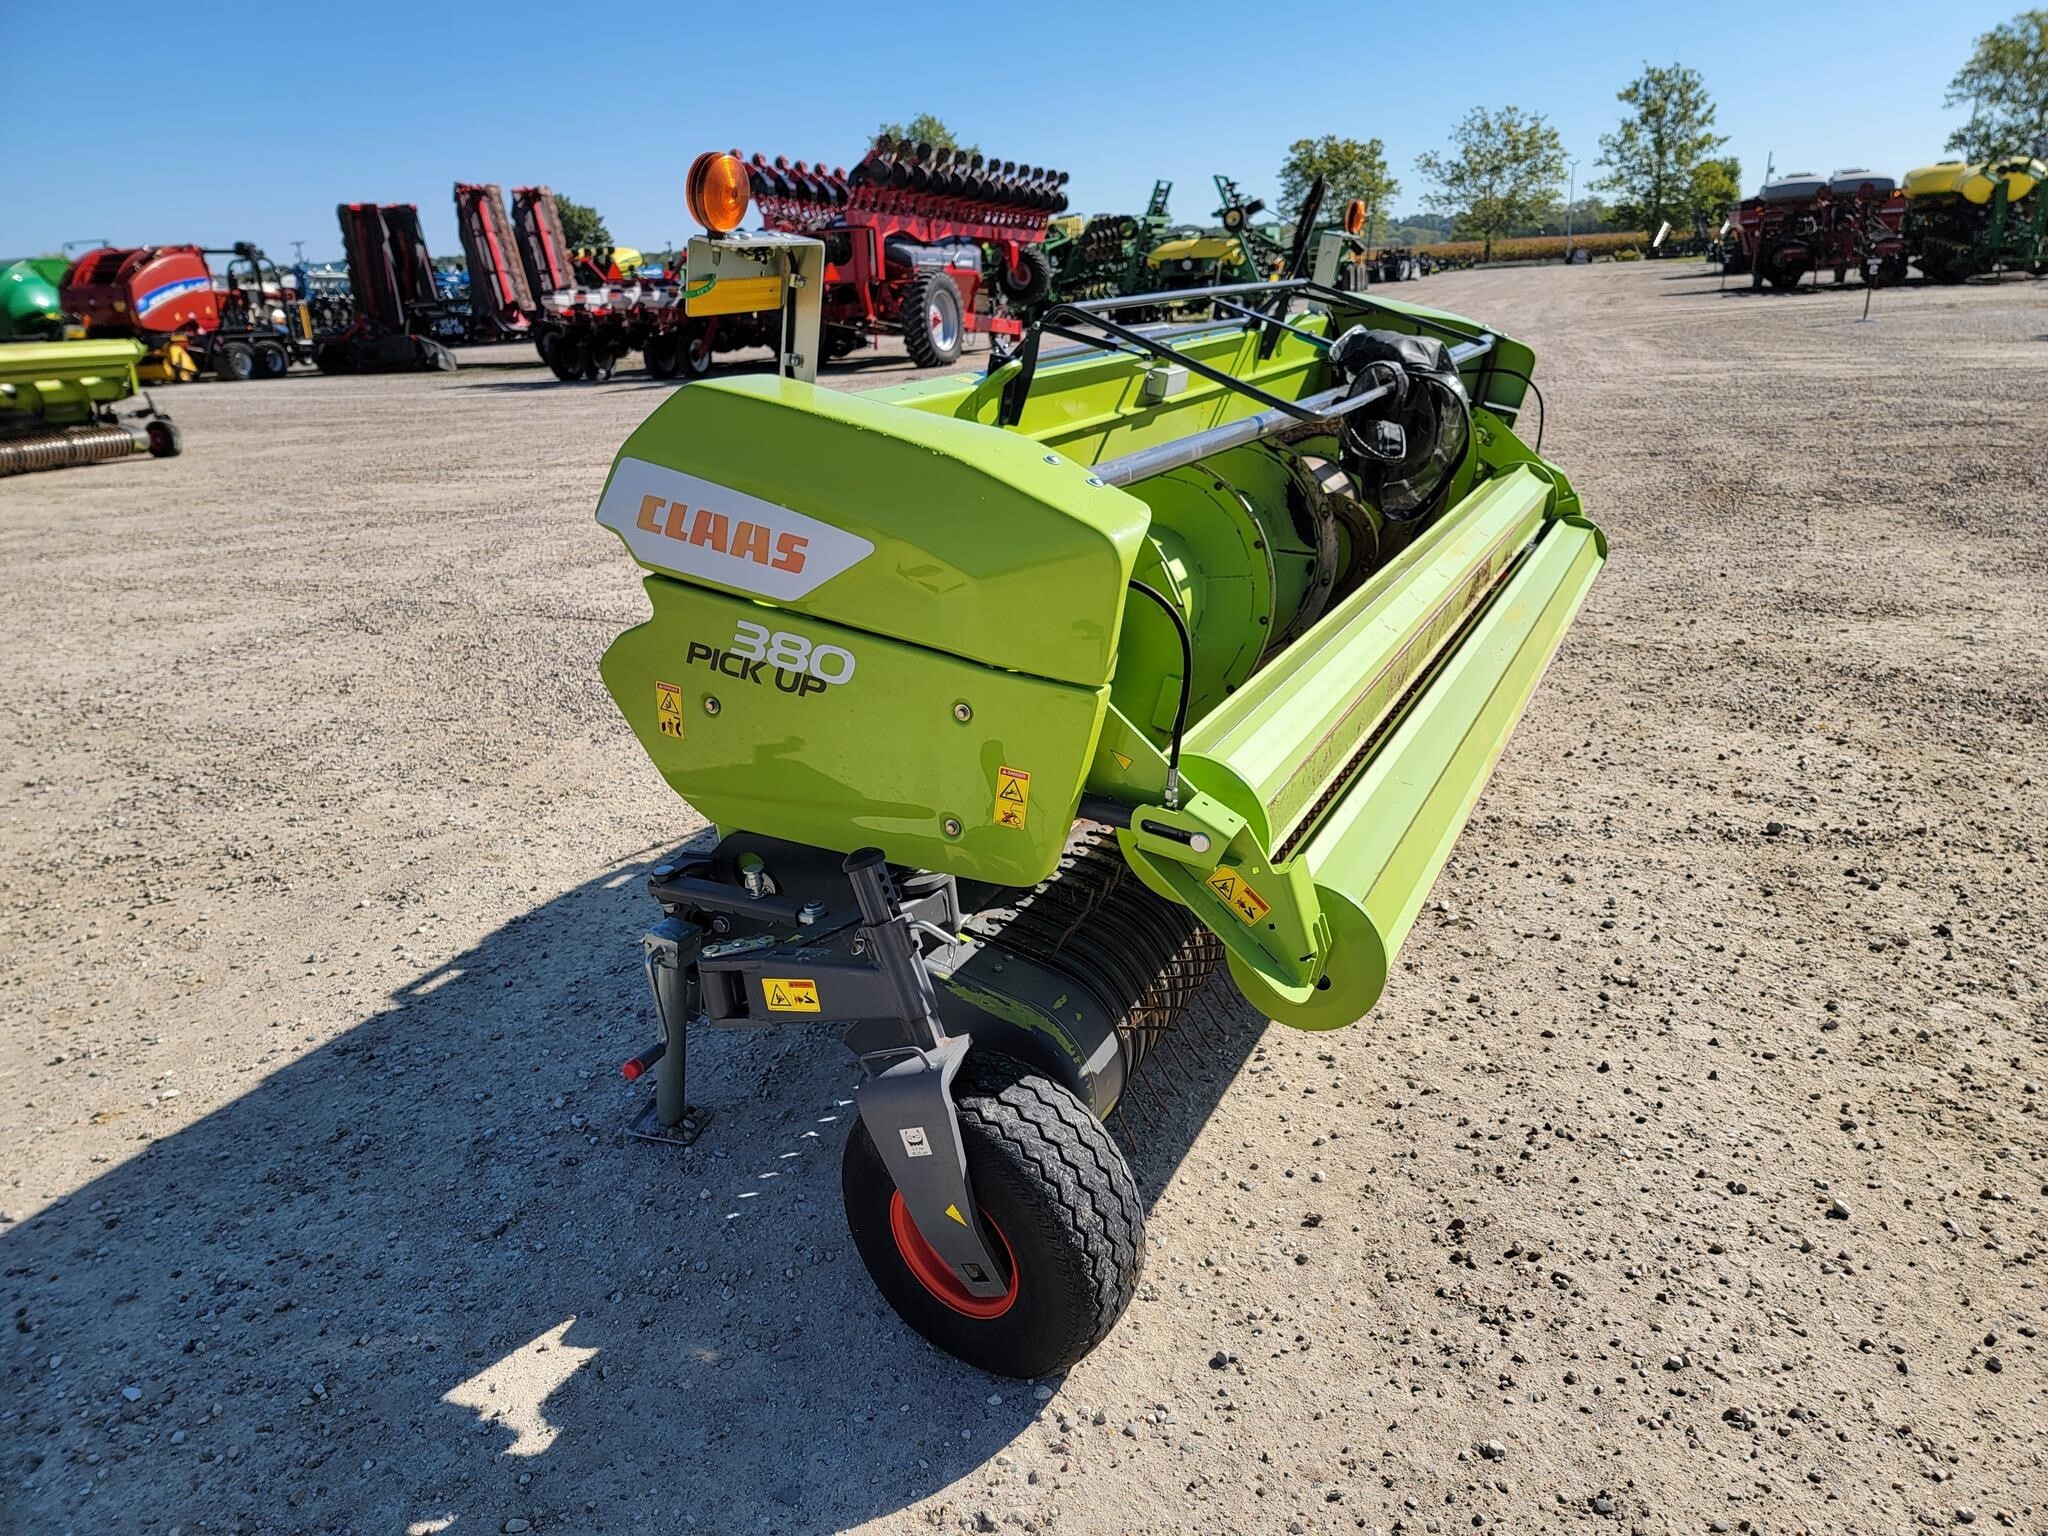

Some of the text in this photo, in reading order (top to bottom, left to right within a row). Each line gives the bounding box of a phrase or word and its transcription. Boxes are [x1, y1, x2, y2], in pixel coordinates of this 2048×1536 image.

[636, 494, 809, 574] CLAAS
[686, 641, 828, 697] PICK UP
[730, 619, 856, 685] 380
